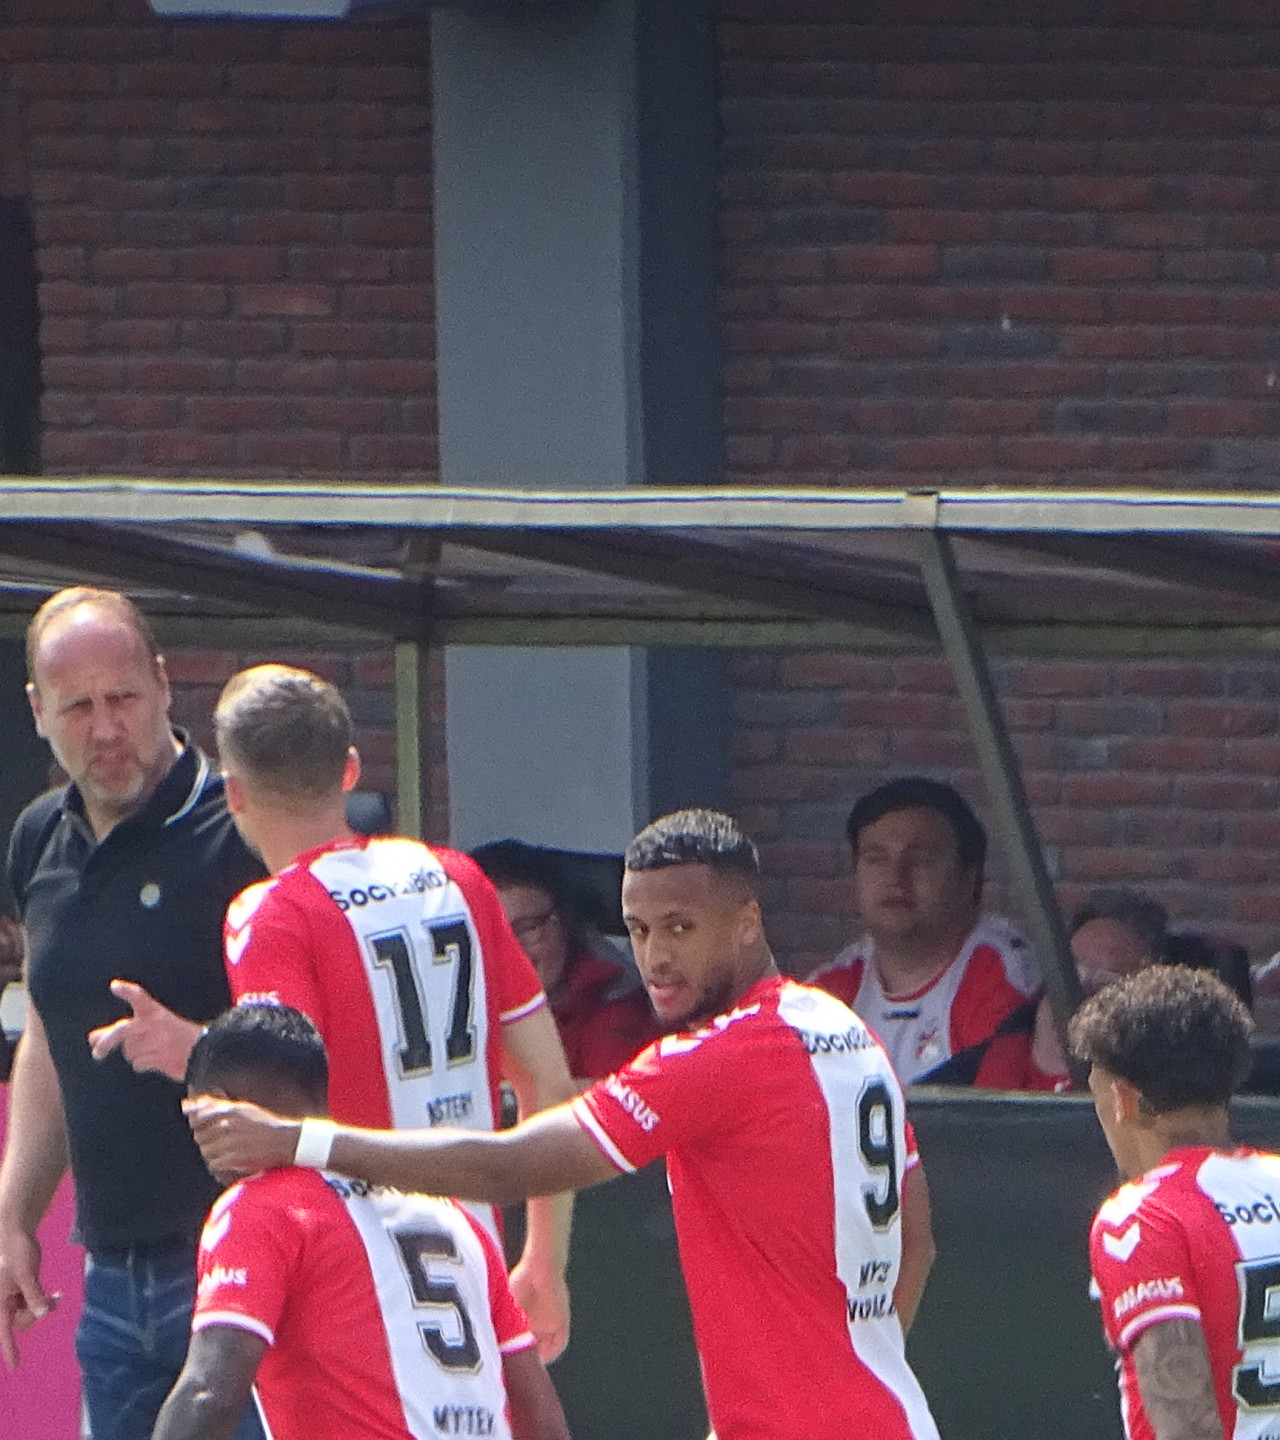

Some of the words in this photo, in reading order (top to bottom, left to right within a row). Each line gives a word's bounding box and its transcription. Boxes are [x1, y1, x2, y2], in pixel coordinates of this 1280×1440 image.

[364, 913, 477, 1082] 17
[858, 1078, 902, 1234] 9
[392, 1226, 485, 1376] 5
